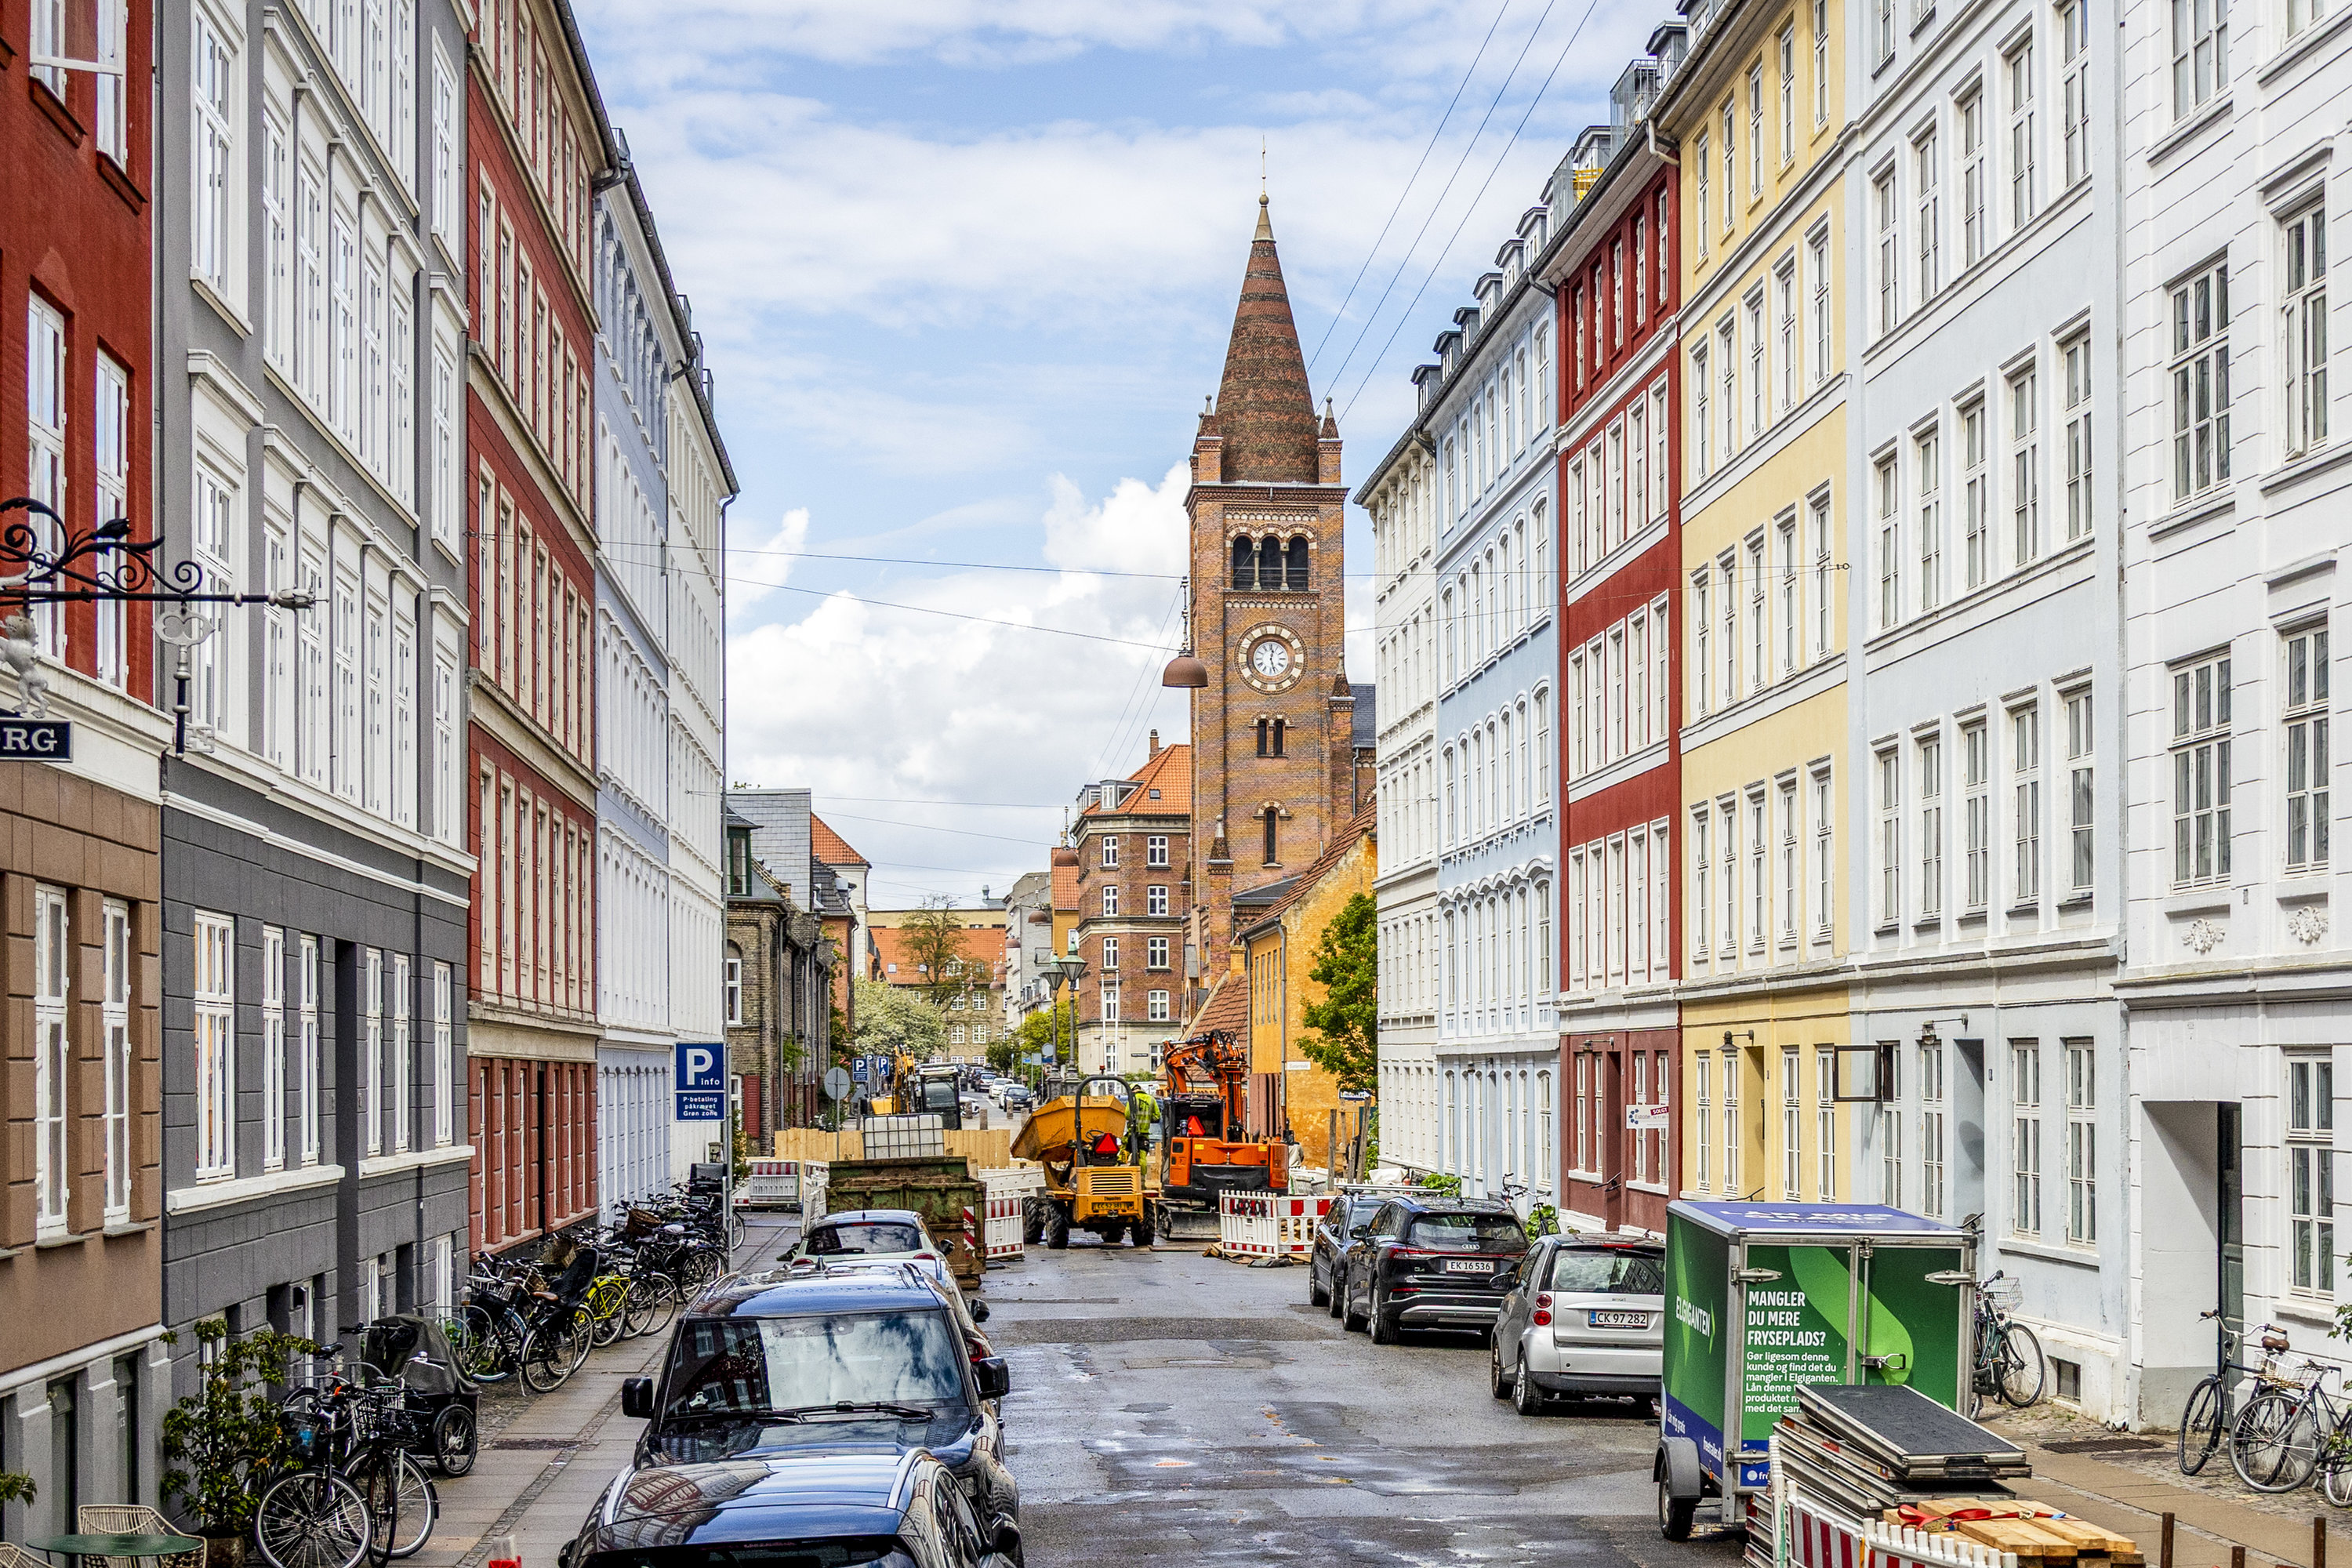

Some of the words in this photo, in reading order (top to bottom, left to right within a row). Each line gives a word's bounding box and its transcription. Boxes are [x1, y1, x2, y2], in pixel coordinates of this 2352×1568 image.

[687, 1049, 713, 1086] P
[855, 1059, 865, 1071] P
[880, 1058, 887, 1068] P
[1748, 1290, 1806, 1307] MANGLER
[1597, 1312, 1610, 1323] CK
[1613, 1313, 1625, 1323] 97
[1628, 1314, 1646, 1323] 282
[1675, 1295, 1711, 1338] ELGIGANTEN
[1748, 1310, 1765, 1326] DU
[1767, 1311, 1801, 1327] MERE
[1747, 1330, 1826, 1347] FRYSEPLADS?
[1747, 1352, 1763, 1360] Gør
[1765, 1352, 1800, 1363] ligesom
[1801, 1352, 1830, 1361] denne
[1746, 1362, 1774, 1371] kunde
[1776, 1365, 1788, 1374] og
[1789, 1363, 1806, 1371] find
[1808, 1363, 1824, 1372] det
[1824, 1363, 1836, 1372] du
[1746, 1373, 1783, 1383] mangler
[1784, 1373, 1788, 1381] i
[1789, 1373, 1838, 1384] Elgiganten.
[1745, 1382, 1762, 1392] Lån
[1763, 1383, 1791, 1392] denne
[1745, 1393, 1789, 1403] produktet
[1745, 1403, 1765, 1413] med
[1766, 1404, 1782, 1413] det
